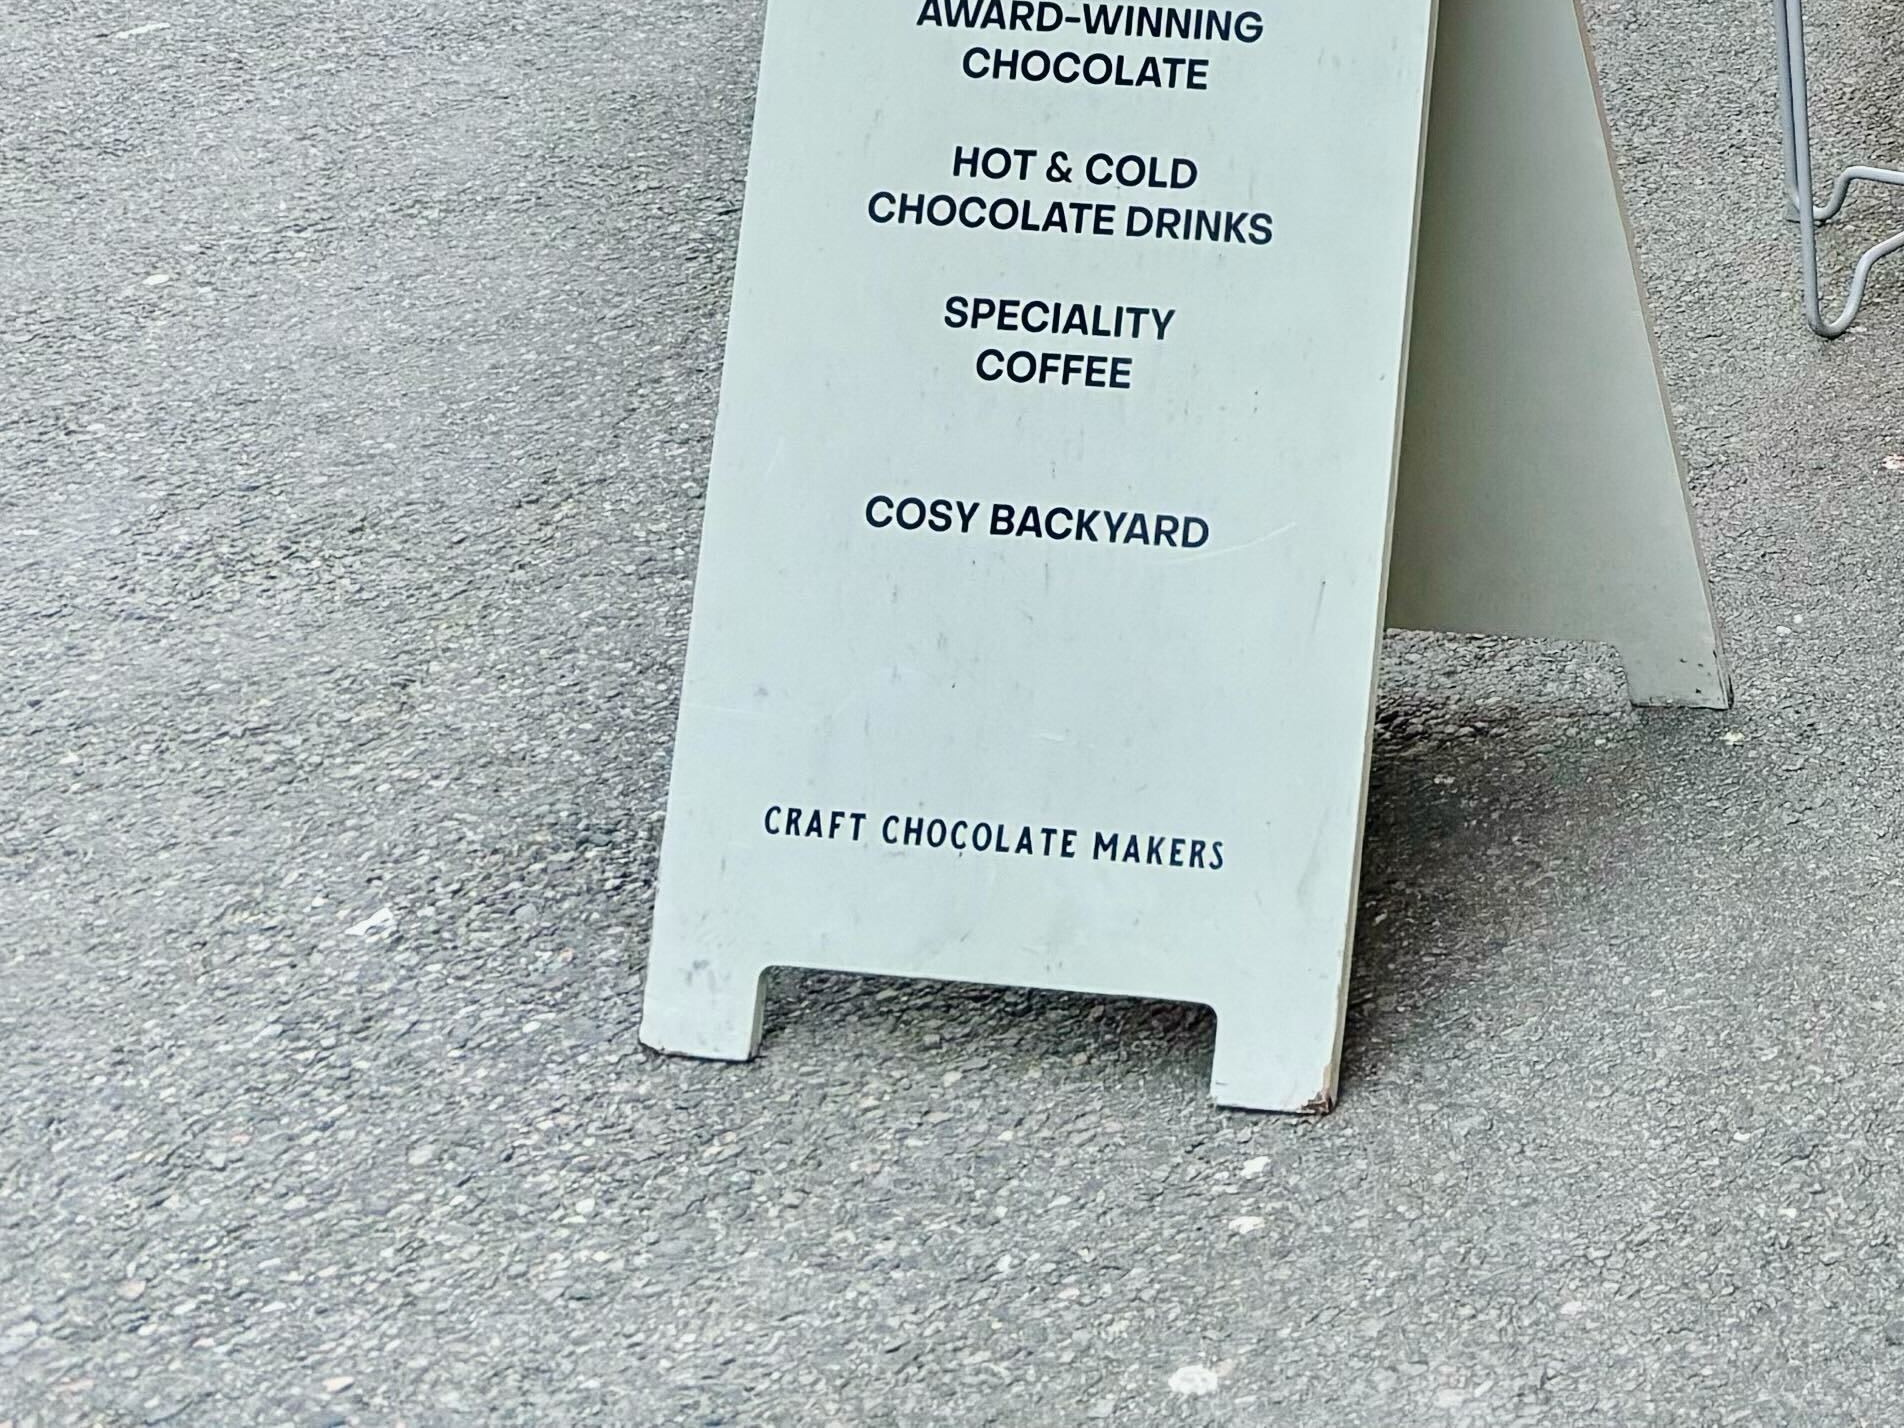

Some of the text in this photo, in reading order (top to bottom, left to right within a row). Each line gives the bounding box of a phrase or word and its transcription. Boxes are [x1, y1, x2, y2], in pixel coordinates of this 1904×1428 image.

[962, 47, 1209, 90] CHOCOLATE
[952, 146, 1198, 189] HOT & COLD
[867, 191, 1274, 245] CHOCOLATE DRINKS
[943, 295, 1176, 341] SPECIALITY
[975, 348, 1133, 389] COFFEE
[865, 495, 1210, 548] COSY BACKYARD
[764, 805, 1225, 872] CRAFT CHOCOLATE MAKERS
